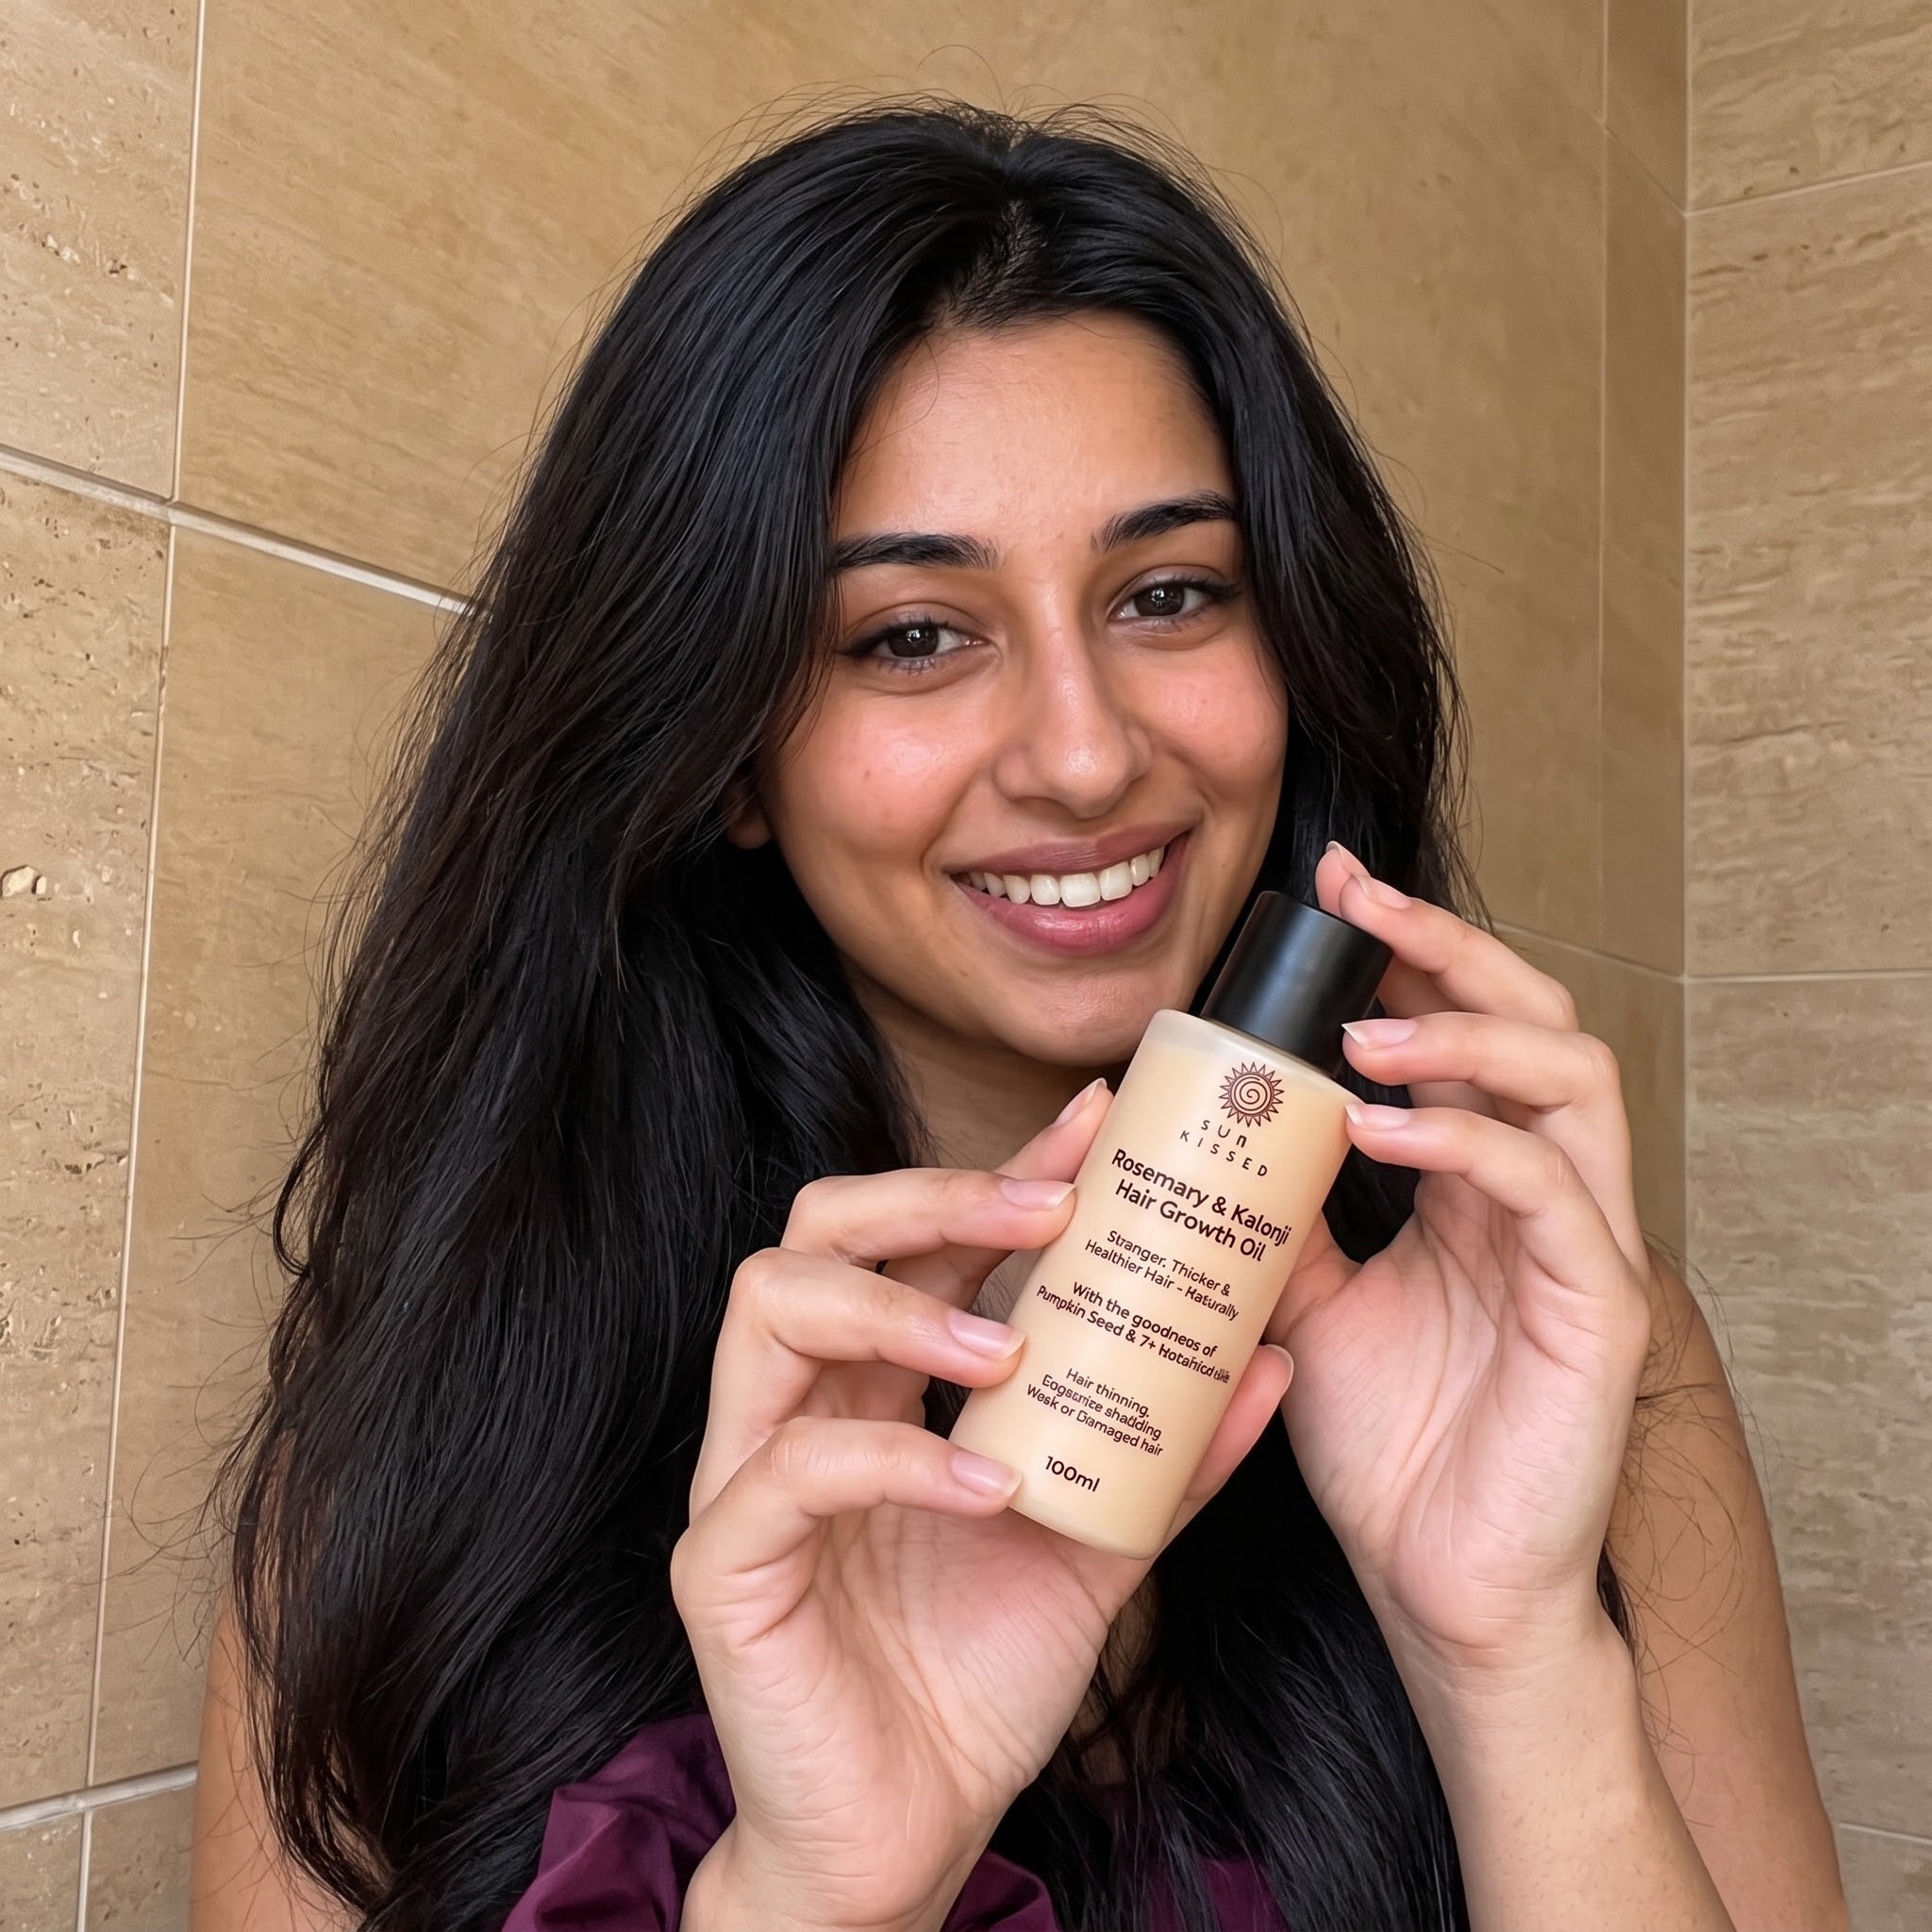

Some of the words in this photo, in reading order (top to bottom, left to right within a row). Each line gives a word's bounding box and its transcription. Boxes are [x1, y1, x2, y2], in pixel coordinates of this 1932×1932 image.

[1180, 1130, 1268, 1176] KISSED
[1111, 1148, 1209, 1208] Rosemary
[1211, 1196, 1227, 1216] &
[1230, 1204, 1292, 1247] Kalonji
[1115, 1178, 1157, 1210] Hair
[1159, 1200, 1236, 1248] Growth
[1240, 1238, 1267, 1262] Oil
[1085, 1239, 1143, 1274] Healthier
[1144, 1266, 1175, 1290] Hair
[1172, 1258, 1221, 1291] Thicker
[1221, 1283, 1231, 1297] &
[1037, 1284, 1087, 1319] Pumpkin
[1087, 1310, 1125, 1337] Seed
[1125, 1329, 1137, 1344] &
[1139, 1334, 1157, 1350] 7+
[1073, 1281, 1104, 1307] With
[1106, 1297, 1130, 1320] the
[1202, 1345, 1218, 1357] of
[1065, 1368, 1094, 1390] Hair
[1060, 1405, 1076, 1417] or
[1140, 1438, 1164, 1457] hair
[1045, 1456, 1101, 1492] 100ml
